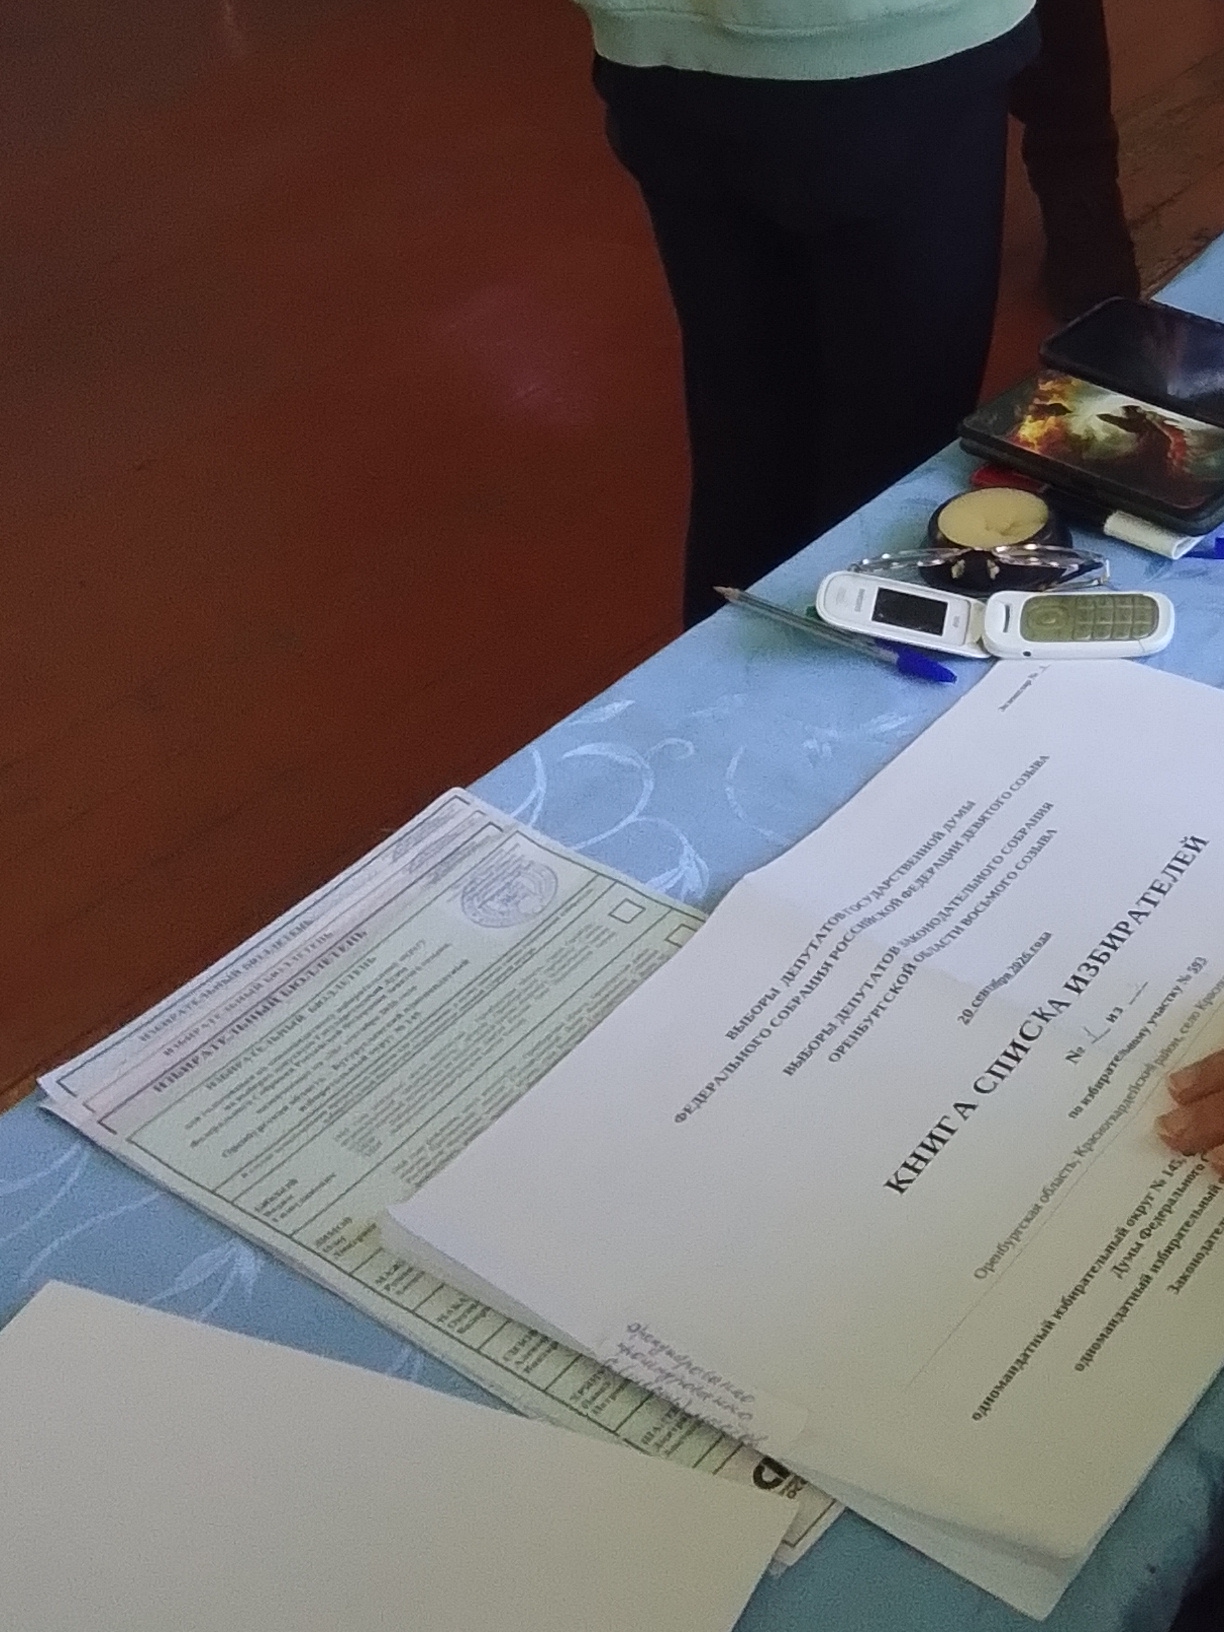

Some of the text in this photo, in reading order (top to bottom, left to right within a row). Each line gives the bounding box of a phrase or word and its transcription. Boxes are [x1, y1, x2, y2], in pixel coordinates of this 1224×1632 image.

[675, 756, 1049, 1122] ФЕДЕРАЛЬНОГО СОБРАНИЯ РОССИЙСКОЙ ФЕДЕРАЦИИ ДЕВЯТОГО СОЗЫВА
[726, 801, 976, 1040] ВЫБОРЫ ДЕПУТАТОВ ГОСУДАРСТВЕННОЙ ДУМЫ
[783, 803, 1053, 1075] ВЫБОРЫ ДЕПУТАТОВ ЗАКОНОДАТЕЛЬНОГО СОБРАНИЯ
[829, 830, 1057, 1062] ОРЕНБУРГСКОЙ ОБЛАСТИ ВОСЬМОГО СОЗЫВА
[885, 837, 1206, 1193] КНИГА СПИСКА ИЗБИРАТЕЛЕЙ
[958, 1009, 975, 1025] 20
[971, 973, 1013, 1008] сентября
[1030, 932, 1052, 955] года
[1065, 1047, 1085, 1064] №
[1106, 1007, 1123, 1023] из
[1068, 957, 1207, 1119] по избирательному участку № 593
[974, 1204, 1043, 1279] Оренбургская
[1039, 1160, 1081, 1203] область,
[1074, 1064, 1156, 1157] Красногвардейский
[1180, 1011, 1200, 1036] село
[1111, 1164, 1205, 1279] Думы Федерального
[973, 1320, 1055, 1420] одномандатный
[1053, 1228, 1128, 1319] избирательный
[1126, 1193, 1154, 1227] округ
[1149, 1179, 1167, 1192] №
[1075, 1185, 1221, 1371] одномандатный избирательный
